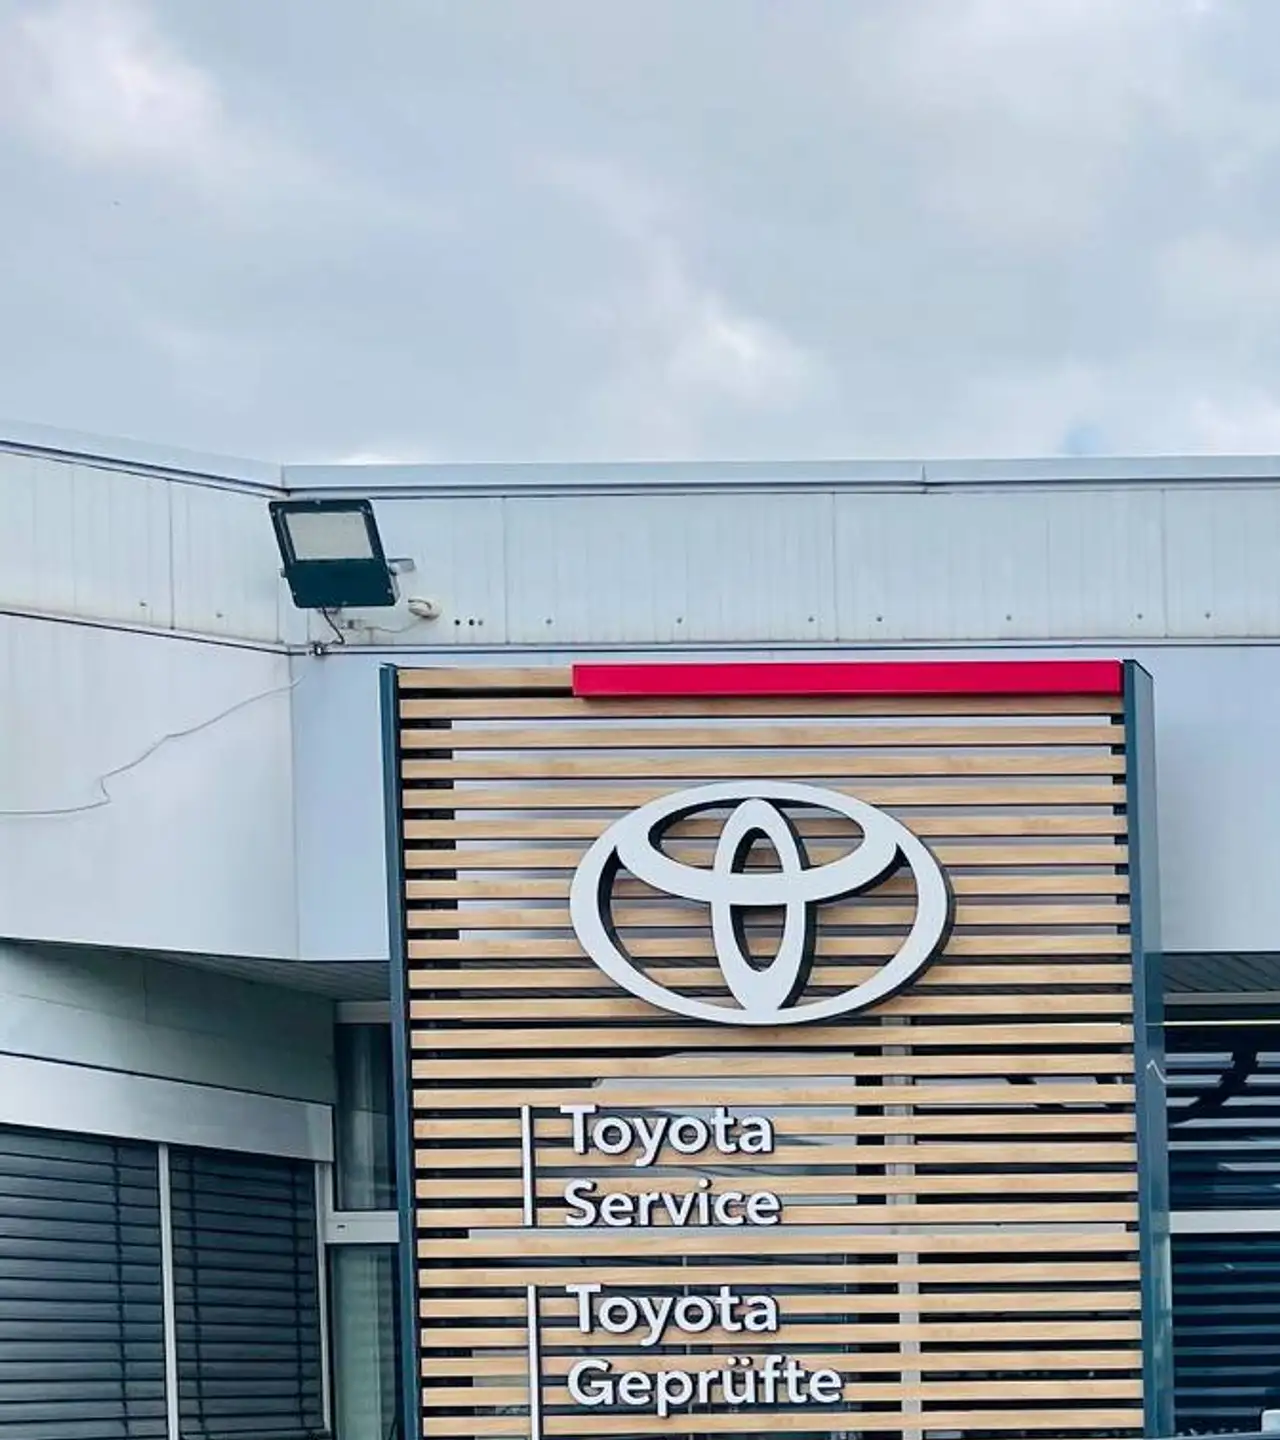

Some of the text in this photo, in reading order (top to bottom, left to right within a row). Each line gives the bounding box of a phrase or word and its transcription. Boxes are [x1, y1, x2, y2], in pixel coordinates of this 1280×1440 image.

[560, 1104, 774, 1167] Toyota
[564, 1178, 780, 1227] Service
[566, 1284, 779, 1346] Toyota
[567, 1354, 842, 1417] Geprüfte
